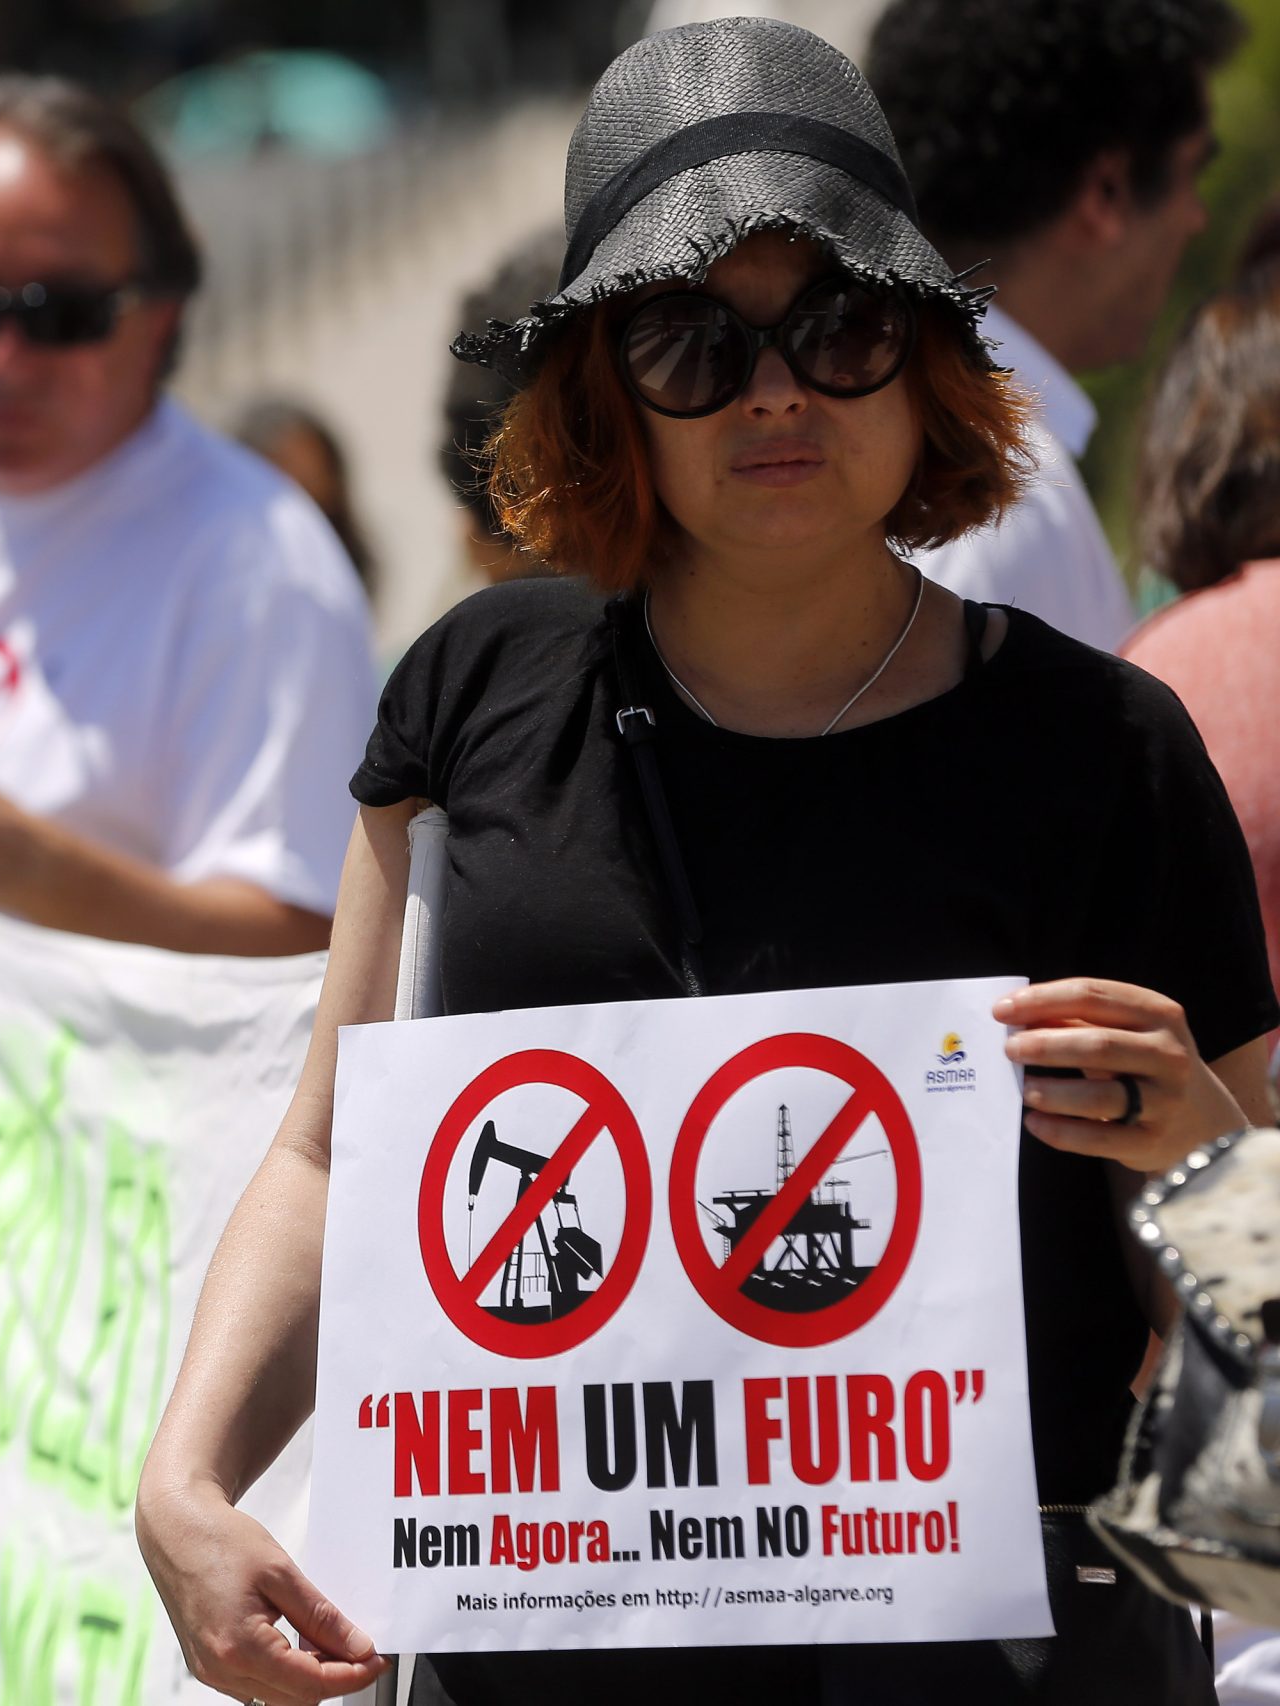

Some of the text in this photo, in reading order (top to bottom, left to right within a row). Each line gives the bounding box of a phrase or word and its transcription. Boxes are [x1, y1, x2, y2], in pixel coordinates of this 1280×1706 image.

[926, 1068, 977, 1084] ASMAA
[358, 1369, 986, 1498] “NEM UM FURO”
[392, 1500, 961, 1572] Nem Agora... Nem NO Futuro!
[456, 1593, 498, 1611] Mais
[503, 1589, 617, 1612] informações
[622, 1591, 650, 1607] em
